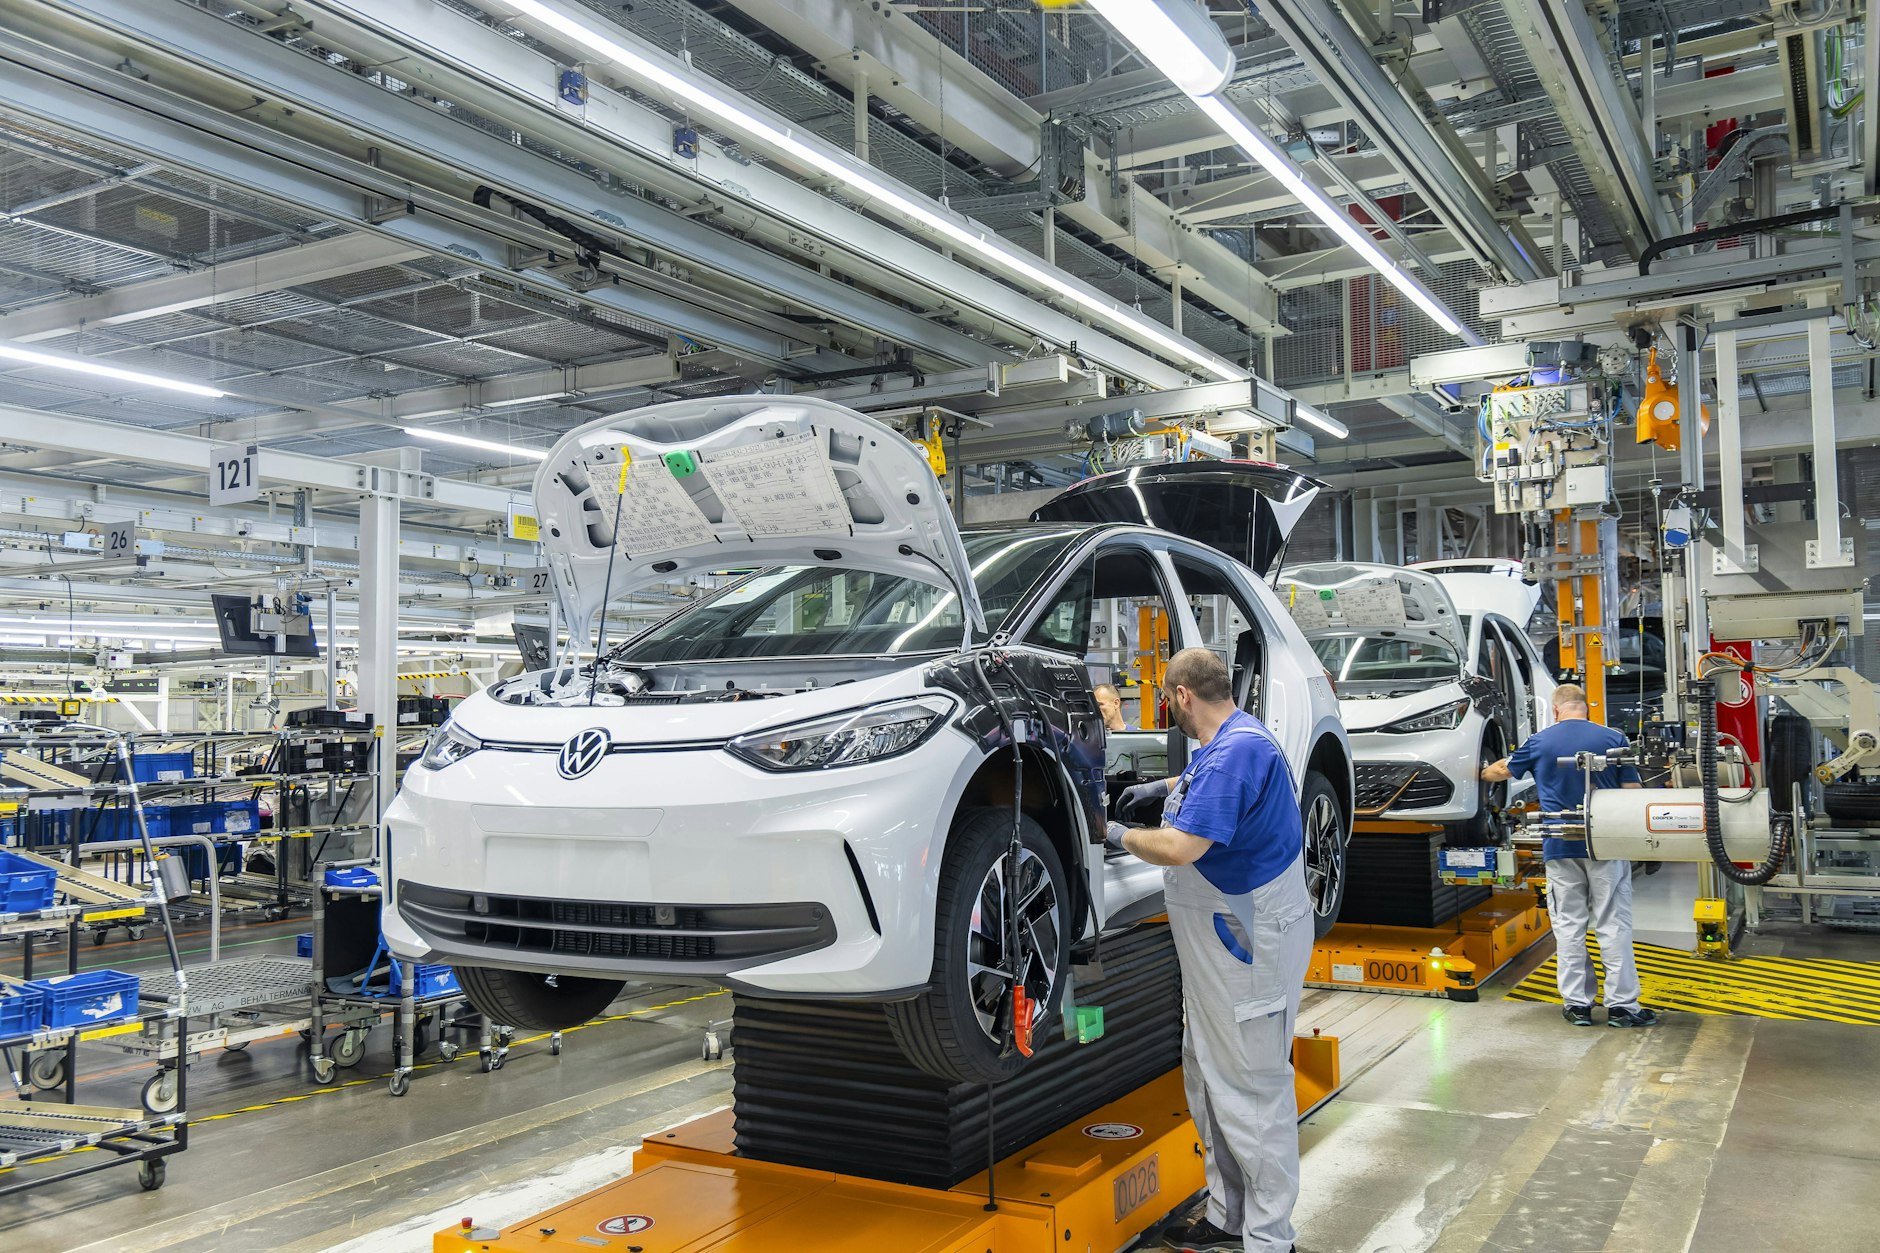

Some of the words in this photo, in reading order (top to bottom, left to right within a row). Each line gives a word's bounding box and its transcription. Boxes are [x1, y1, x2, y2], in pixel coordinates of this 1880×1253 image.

[217, 457, 251, 491] 121
[111, 530, 127, 550] 26
[533, 573, 548, 588] 27
[1095, 625, 1107, 635] 30
[558, 729, 607, 779] VW
[1369, 962, 1419, 983] 0001
[211, 1001, 225, 1011] AG
[1118, 1160, 1157, 1215] 0026
